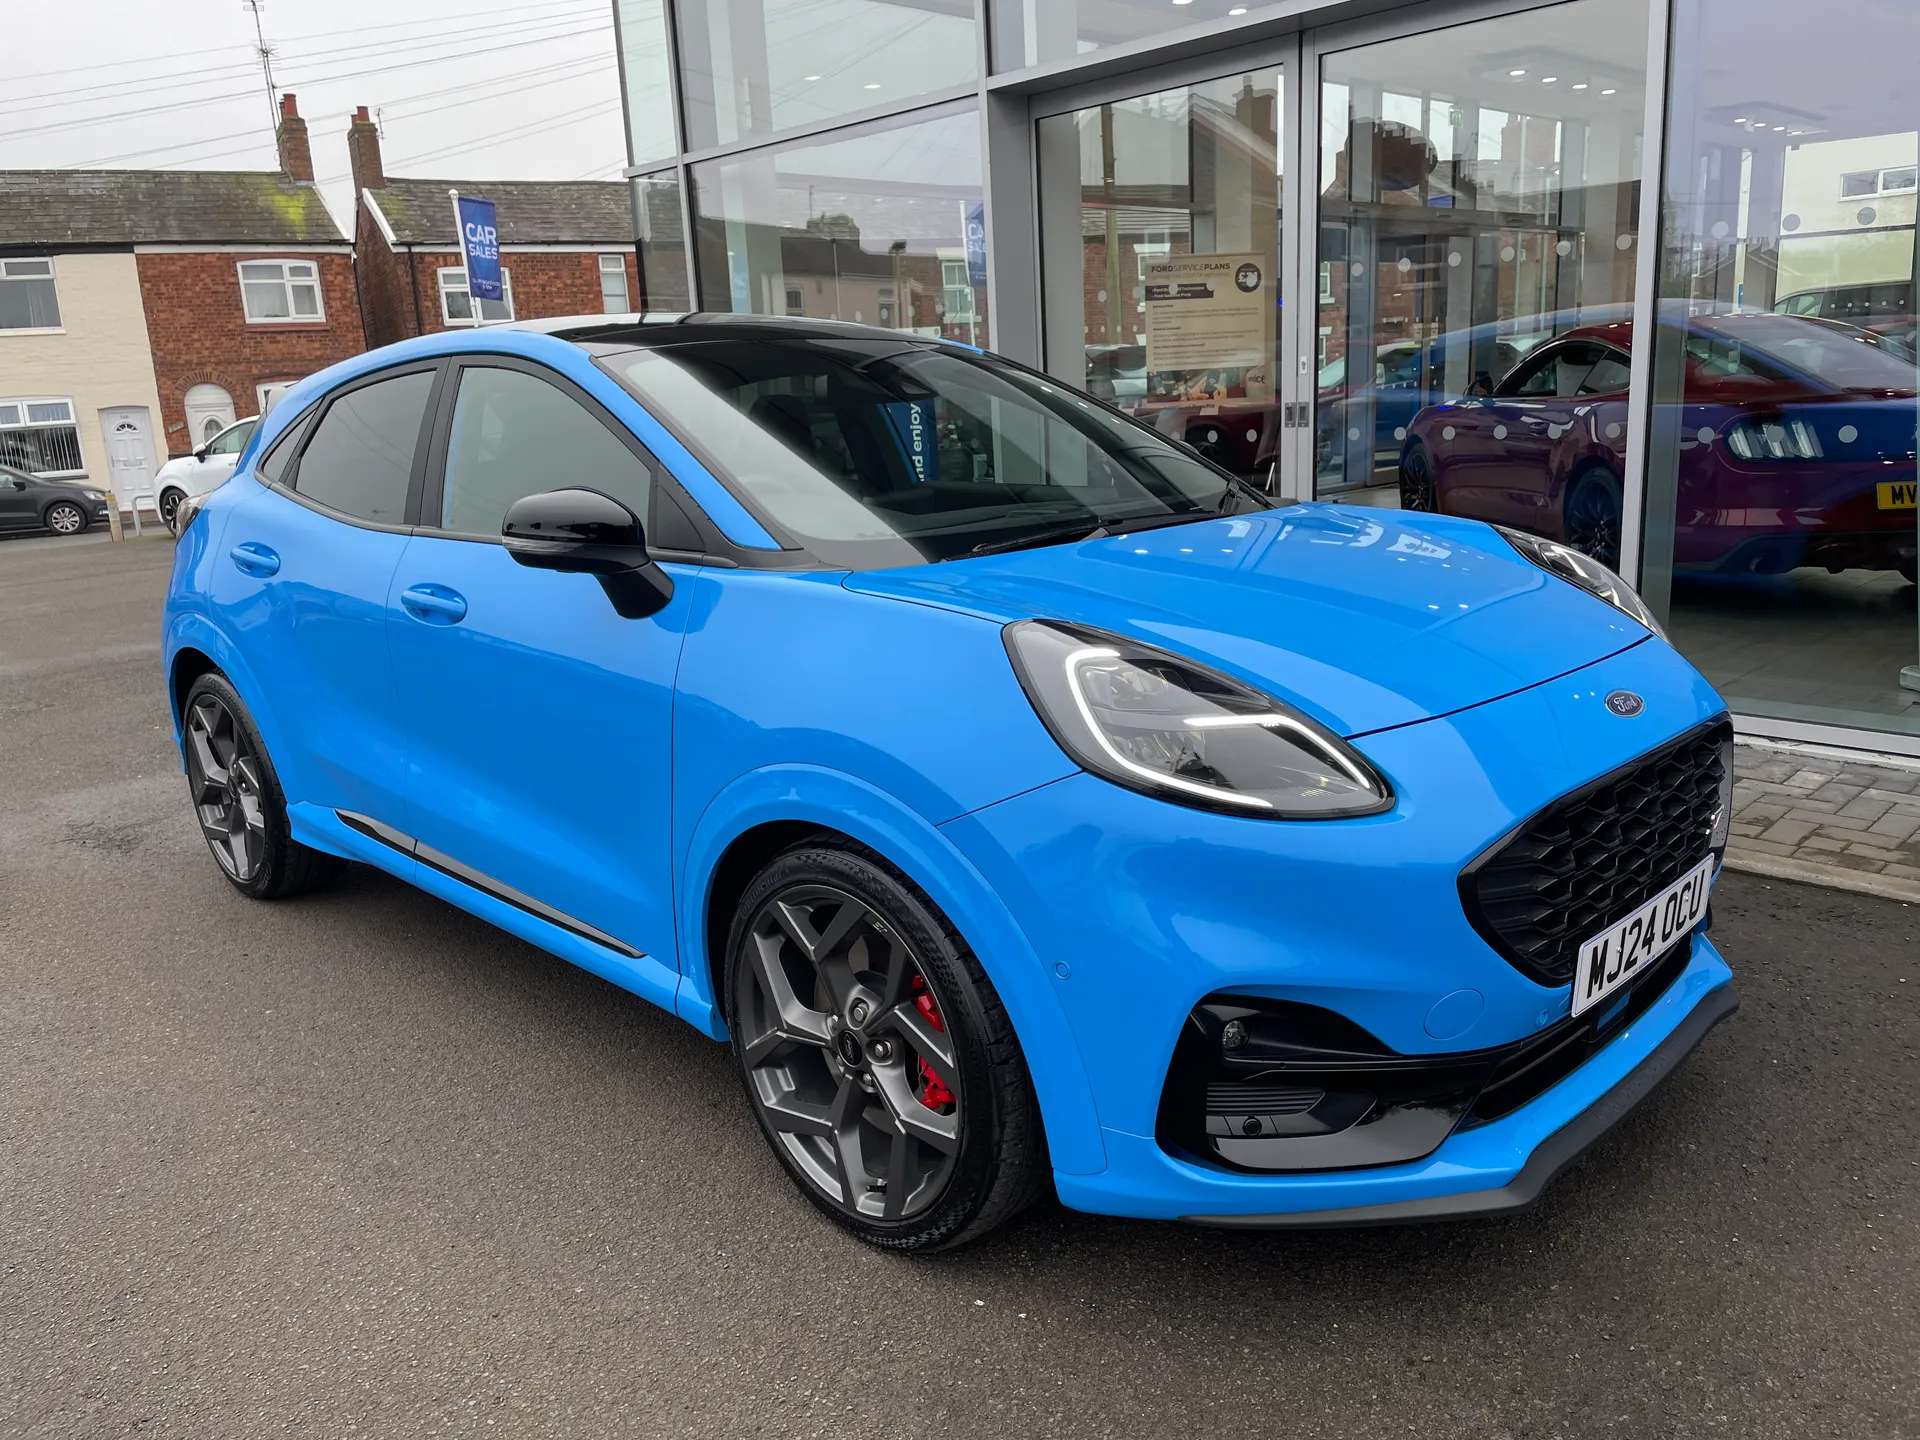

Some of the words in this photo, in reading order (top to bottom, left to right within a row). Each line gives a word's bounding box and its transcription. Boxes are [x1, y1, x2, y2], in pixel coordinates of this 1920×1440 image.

[465, 222, 497, 246] CAR
[468, 243, 498, 260] SALES
[909, 402, 923, 452] enjoy
[911, 455, 925, 482] nd
[1613, 695, 1639, 712] Ford
[1586, 905, 1658, 999] MJ24
[1661, 869, 1706, 944] OCU
